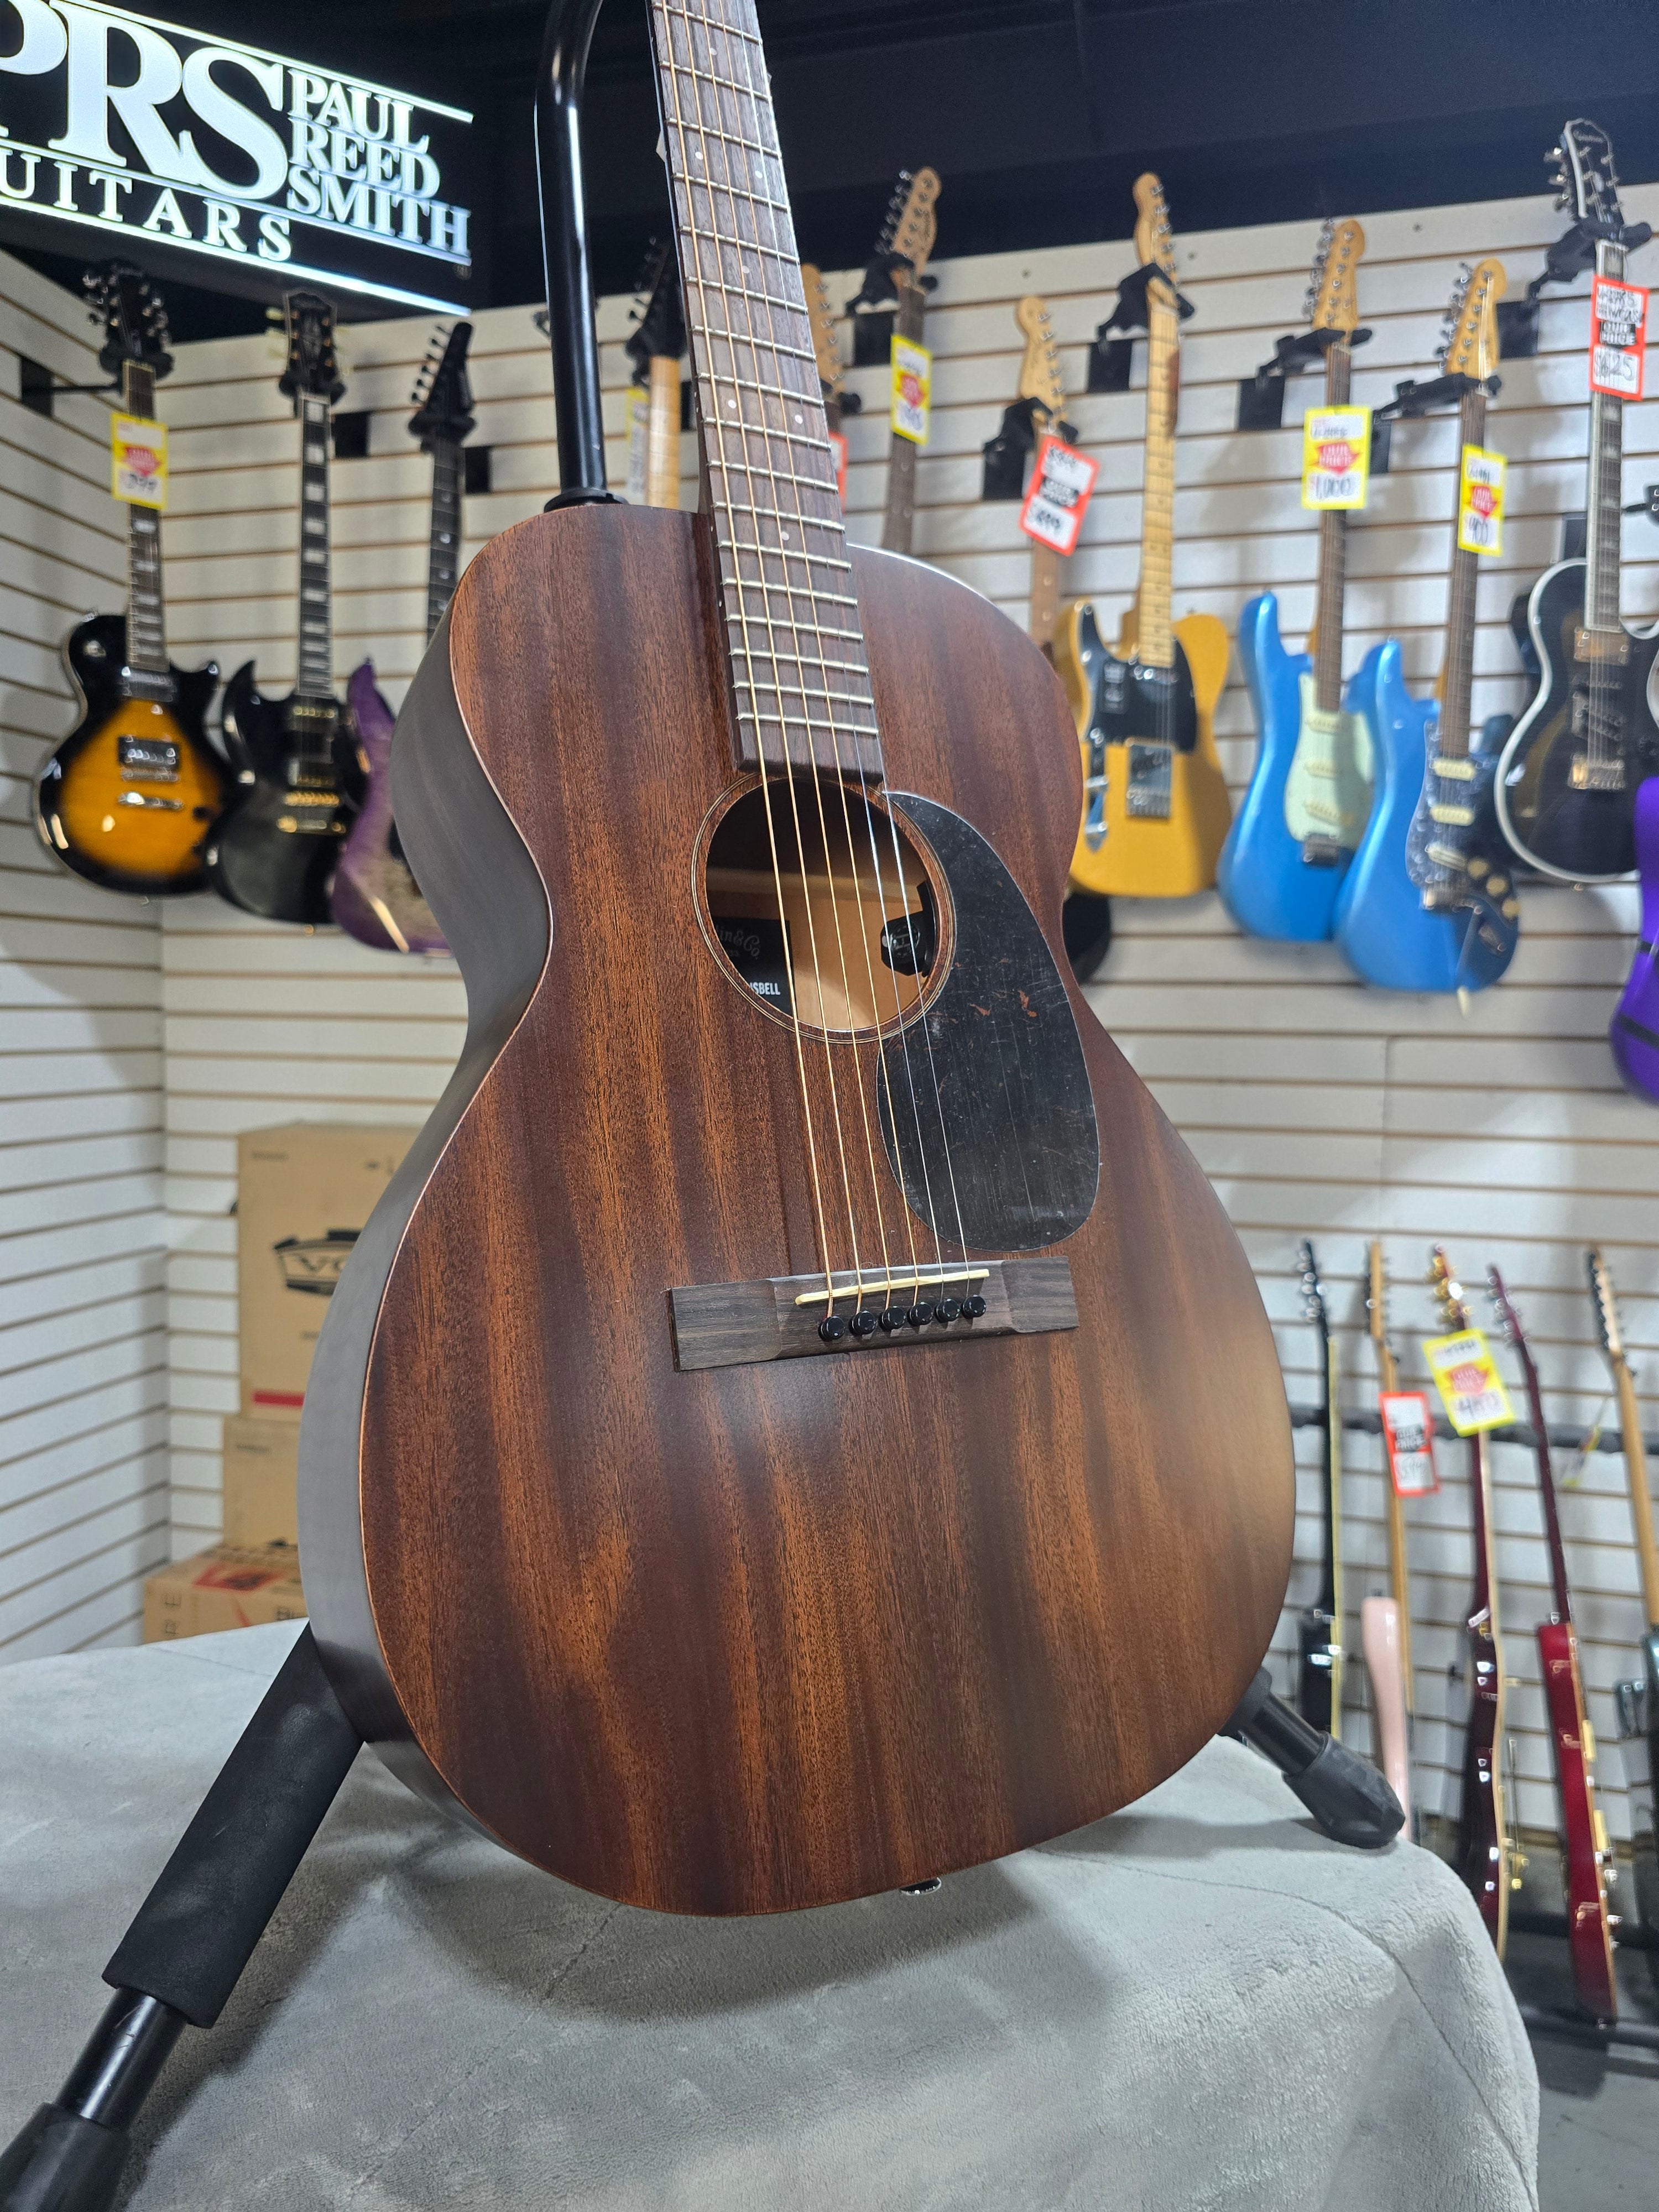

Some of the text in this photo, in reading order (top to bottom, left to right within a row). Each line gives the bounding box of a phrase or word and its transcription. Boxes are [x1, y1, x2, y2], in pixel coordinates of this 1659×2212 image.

[288, 69, 430, 155] PAUL
[288, 116, 440, 199] REED
[287, 165, 471, 257] SMITH
